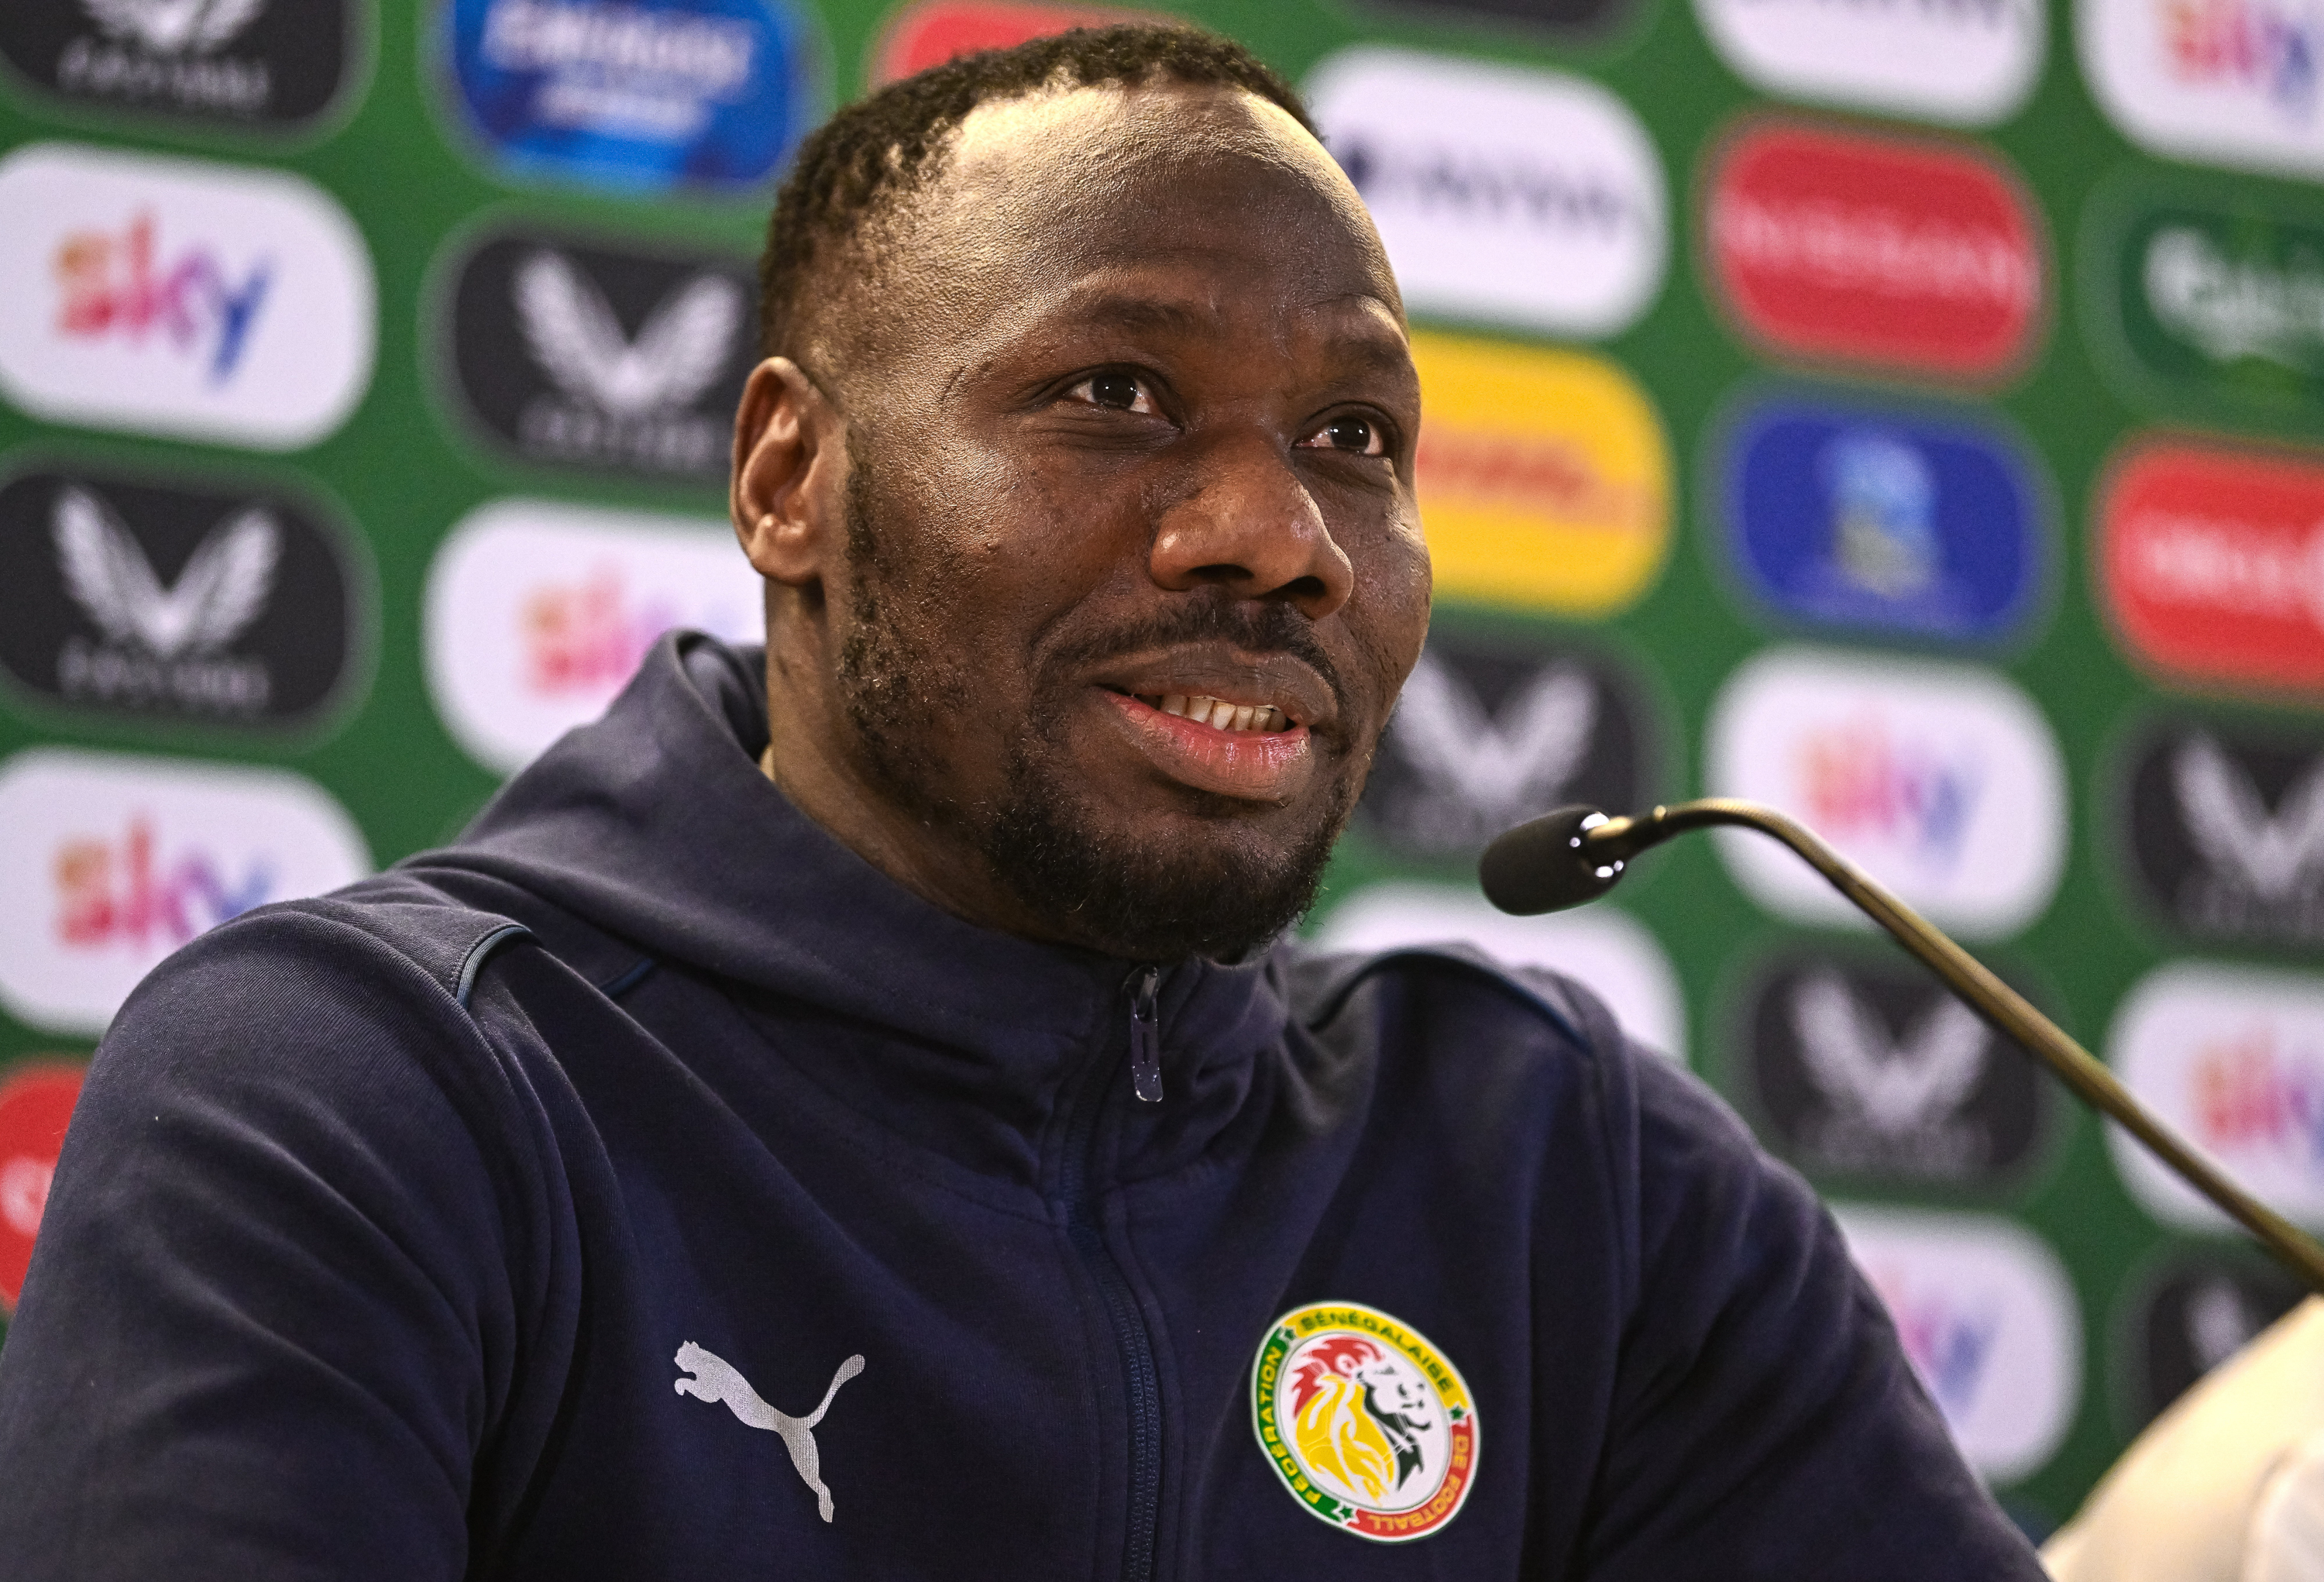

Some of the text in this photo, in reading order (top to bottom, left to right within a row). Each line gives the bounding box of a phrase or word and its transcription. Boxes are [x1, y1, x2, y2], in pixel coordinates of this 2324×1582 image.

[53, 211, 274, 387] sky
[1453, 1435, 1470, 1470] DE
[1367, 1473, 1462, 1531] FOOTBALL
